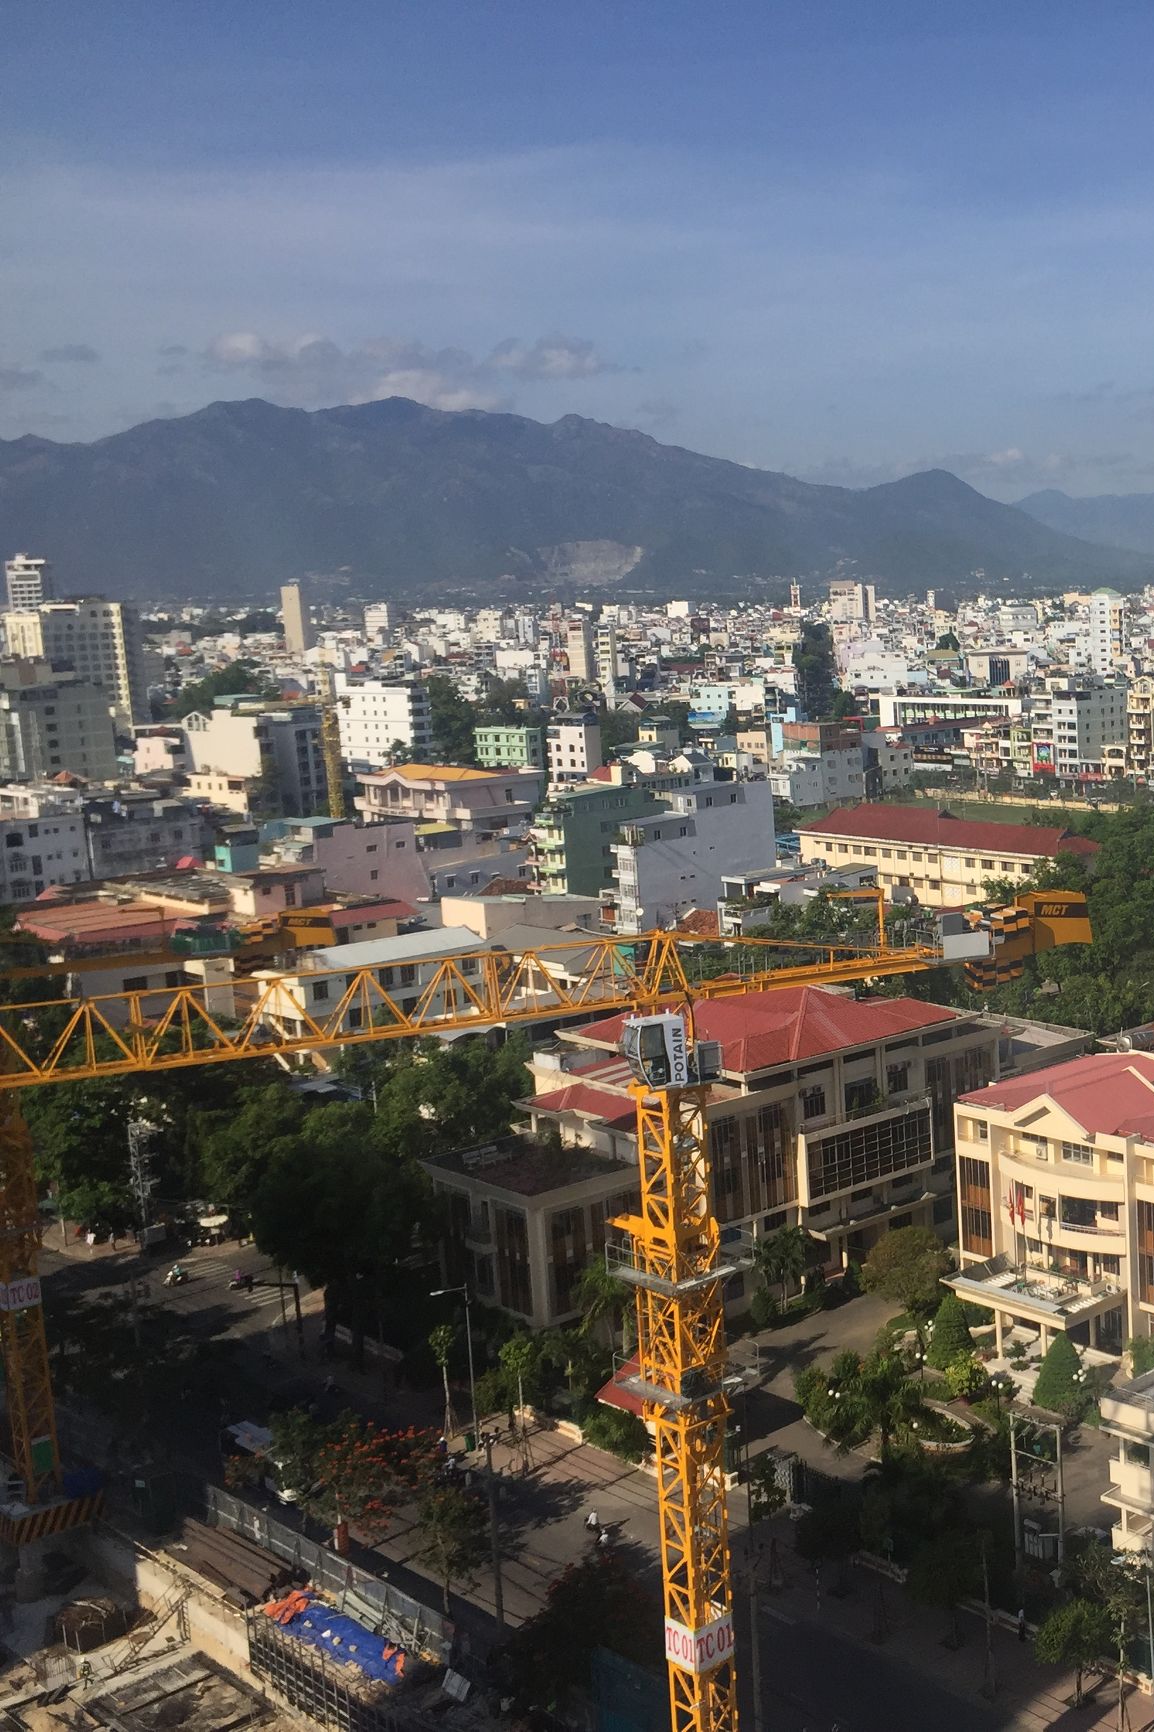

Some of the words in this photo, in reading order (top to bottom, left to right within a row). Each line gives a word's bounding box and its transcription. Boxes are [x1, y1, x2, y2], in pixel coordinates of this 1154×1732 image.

[1040, 904, 1069, 916] MCT
[672, 1028, 685, 1082] POTAIN
[666, 1626, 680, 1656] TC
[681, 1634, 694, 1664] 01
[696, 1632, 715, 1663] TC
[717, 1622, 733, 1653] 01
